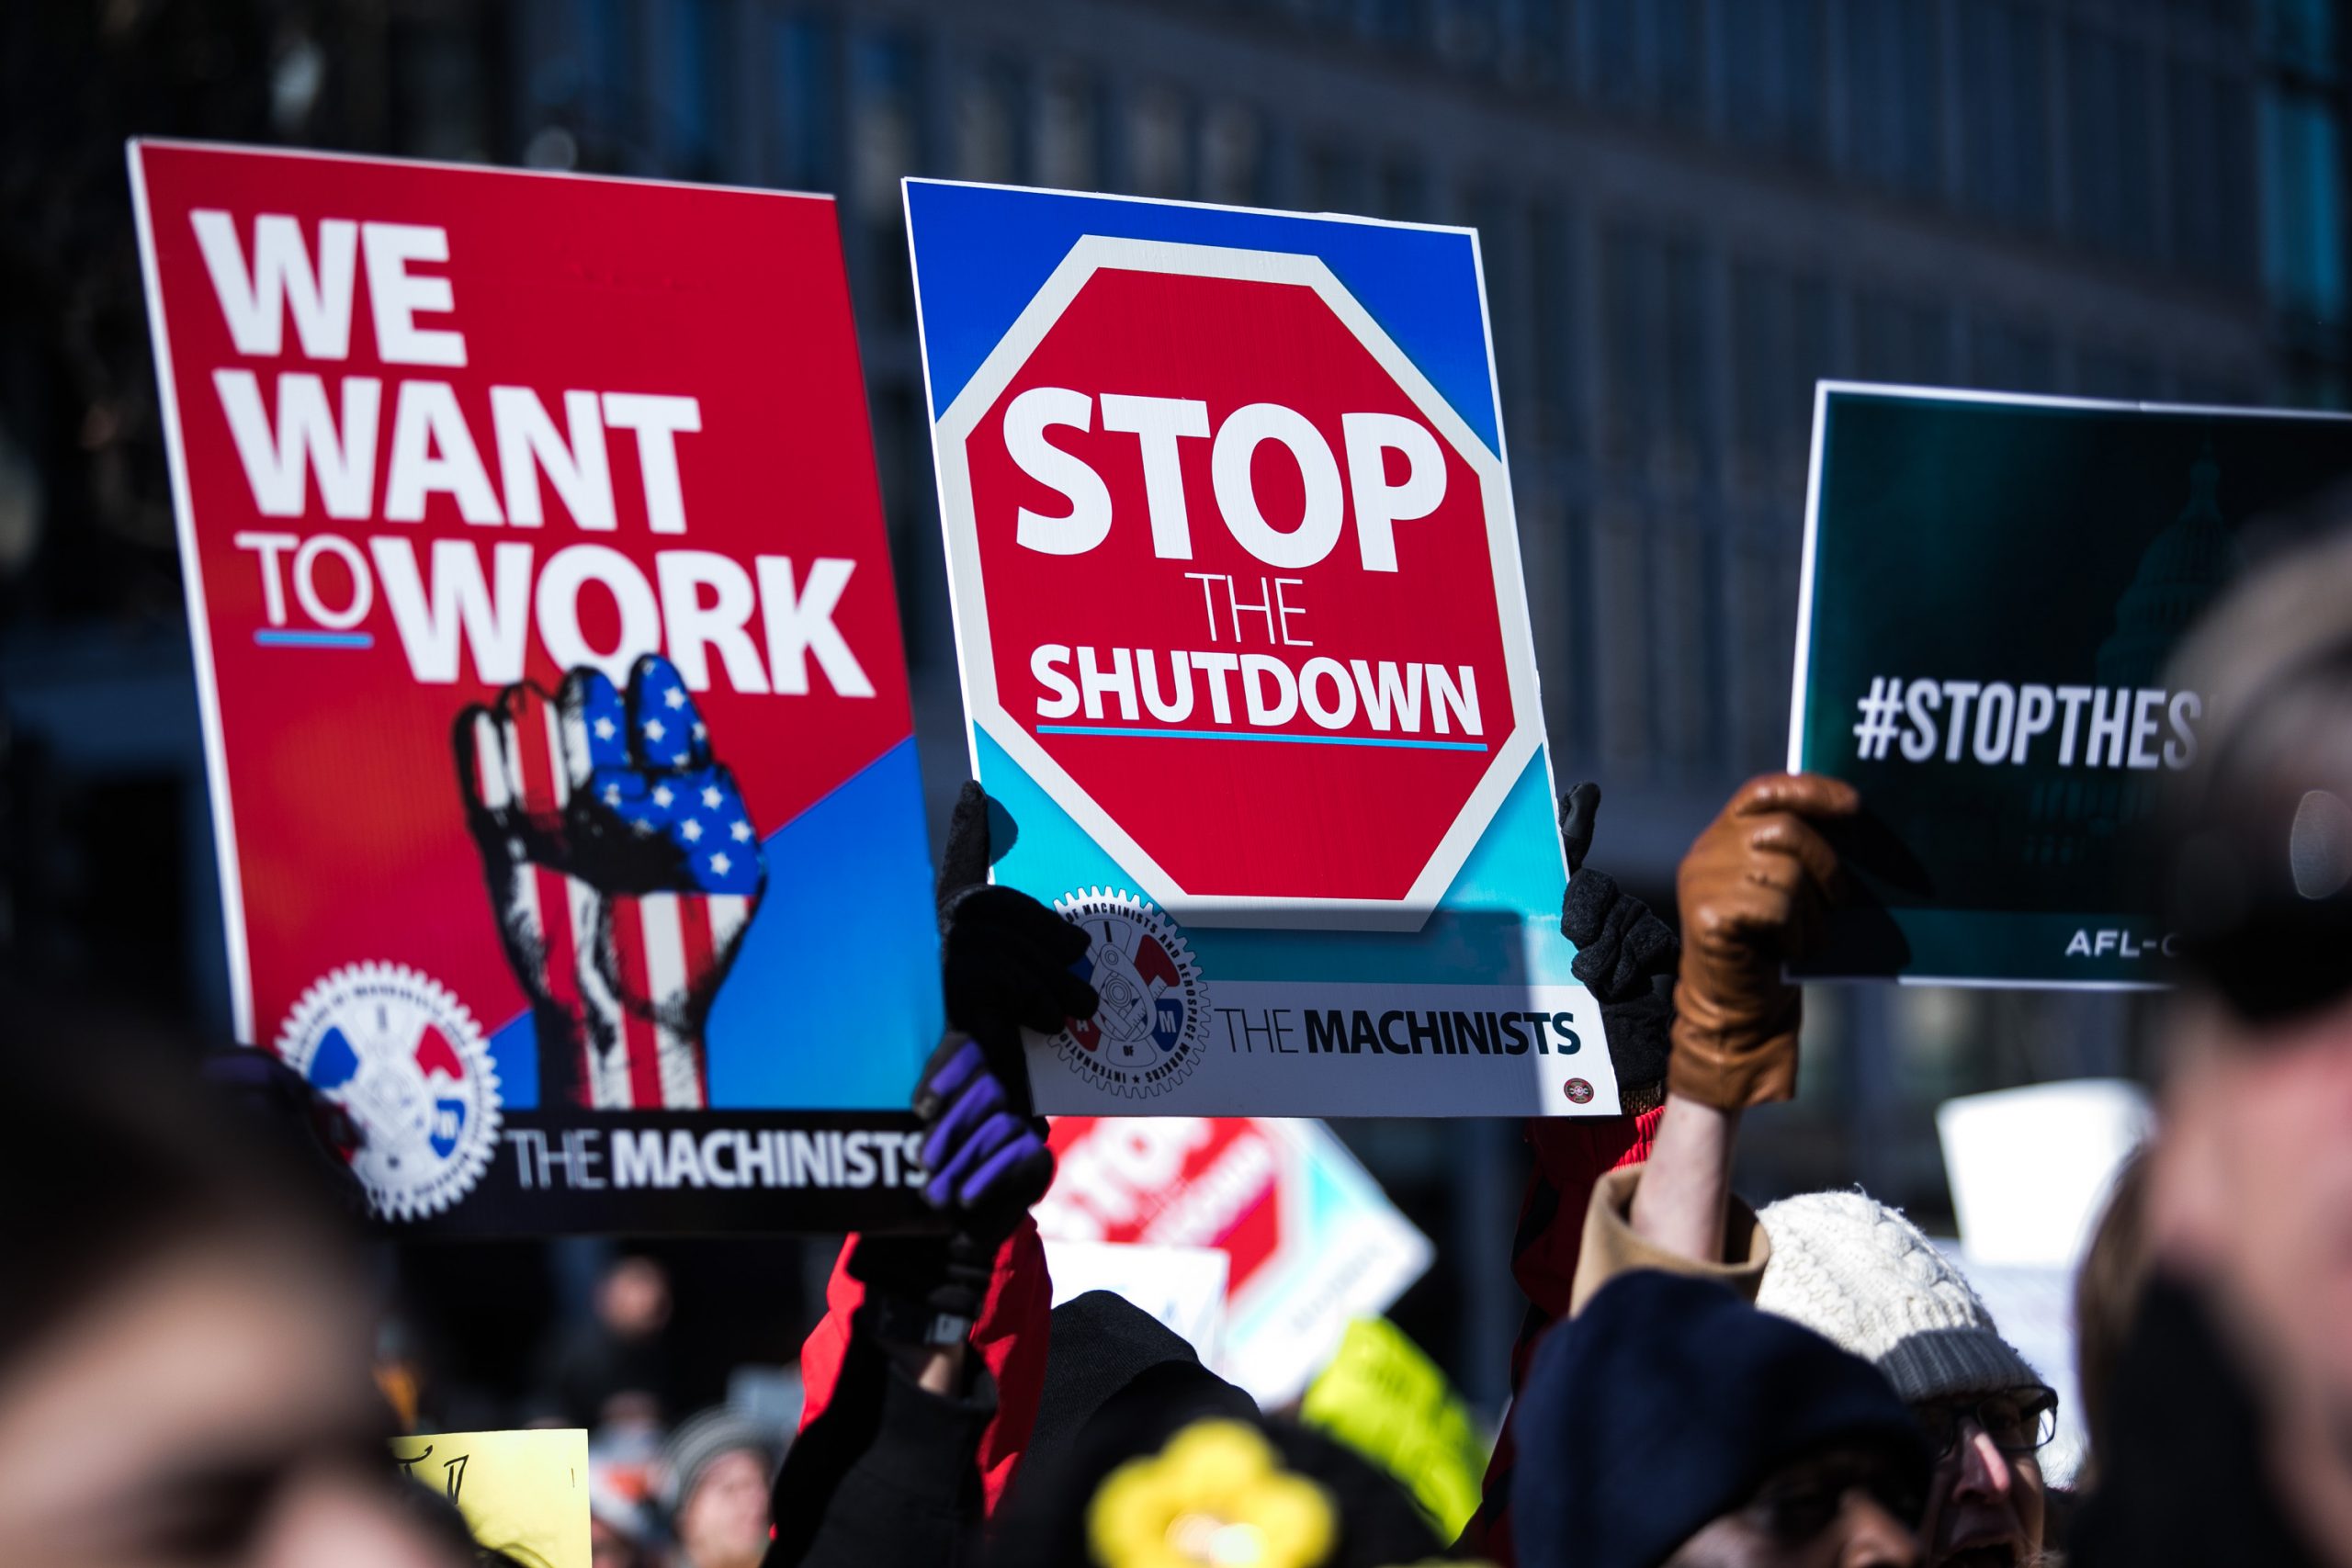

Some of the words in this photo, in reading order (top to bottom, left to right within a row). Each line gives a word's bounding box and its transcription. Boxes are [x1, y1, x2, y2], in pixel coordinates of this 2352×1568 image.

[188, 209, 468, 367] WE
[212, 368, 702, 534] WANT
[1002, 386, 1448, 573] STOP
[234, 531, 374, 630] TO
[368, 536, 876, 698] WORK
[1184, 571, 1314, 647] THE
[1030, 643, 1484, 736] SHUTDOWN
[1853, 676, 2202, 771] #STOPTHES
[1082, 903, 1158, 933] MACHINISTS
[1158, 933, 1181, 959] AND
[2064, 928, 2181, 958] AFL-C
[1177, 963, 1198, 1041] AEROSPACE
[1214, 1008, 1298, 1055] THE
[1305, 1009, 1582, 1056] MACHINISTS
[1059, 1032, 1126, 1084] INTERNATIO
[1145, 1042, 1191, 1083] WORKERS
[505, 1129, 606, 1189] THE
[613, 1130, 929, 1189] MACHINISTS
